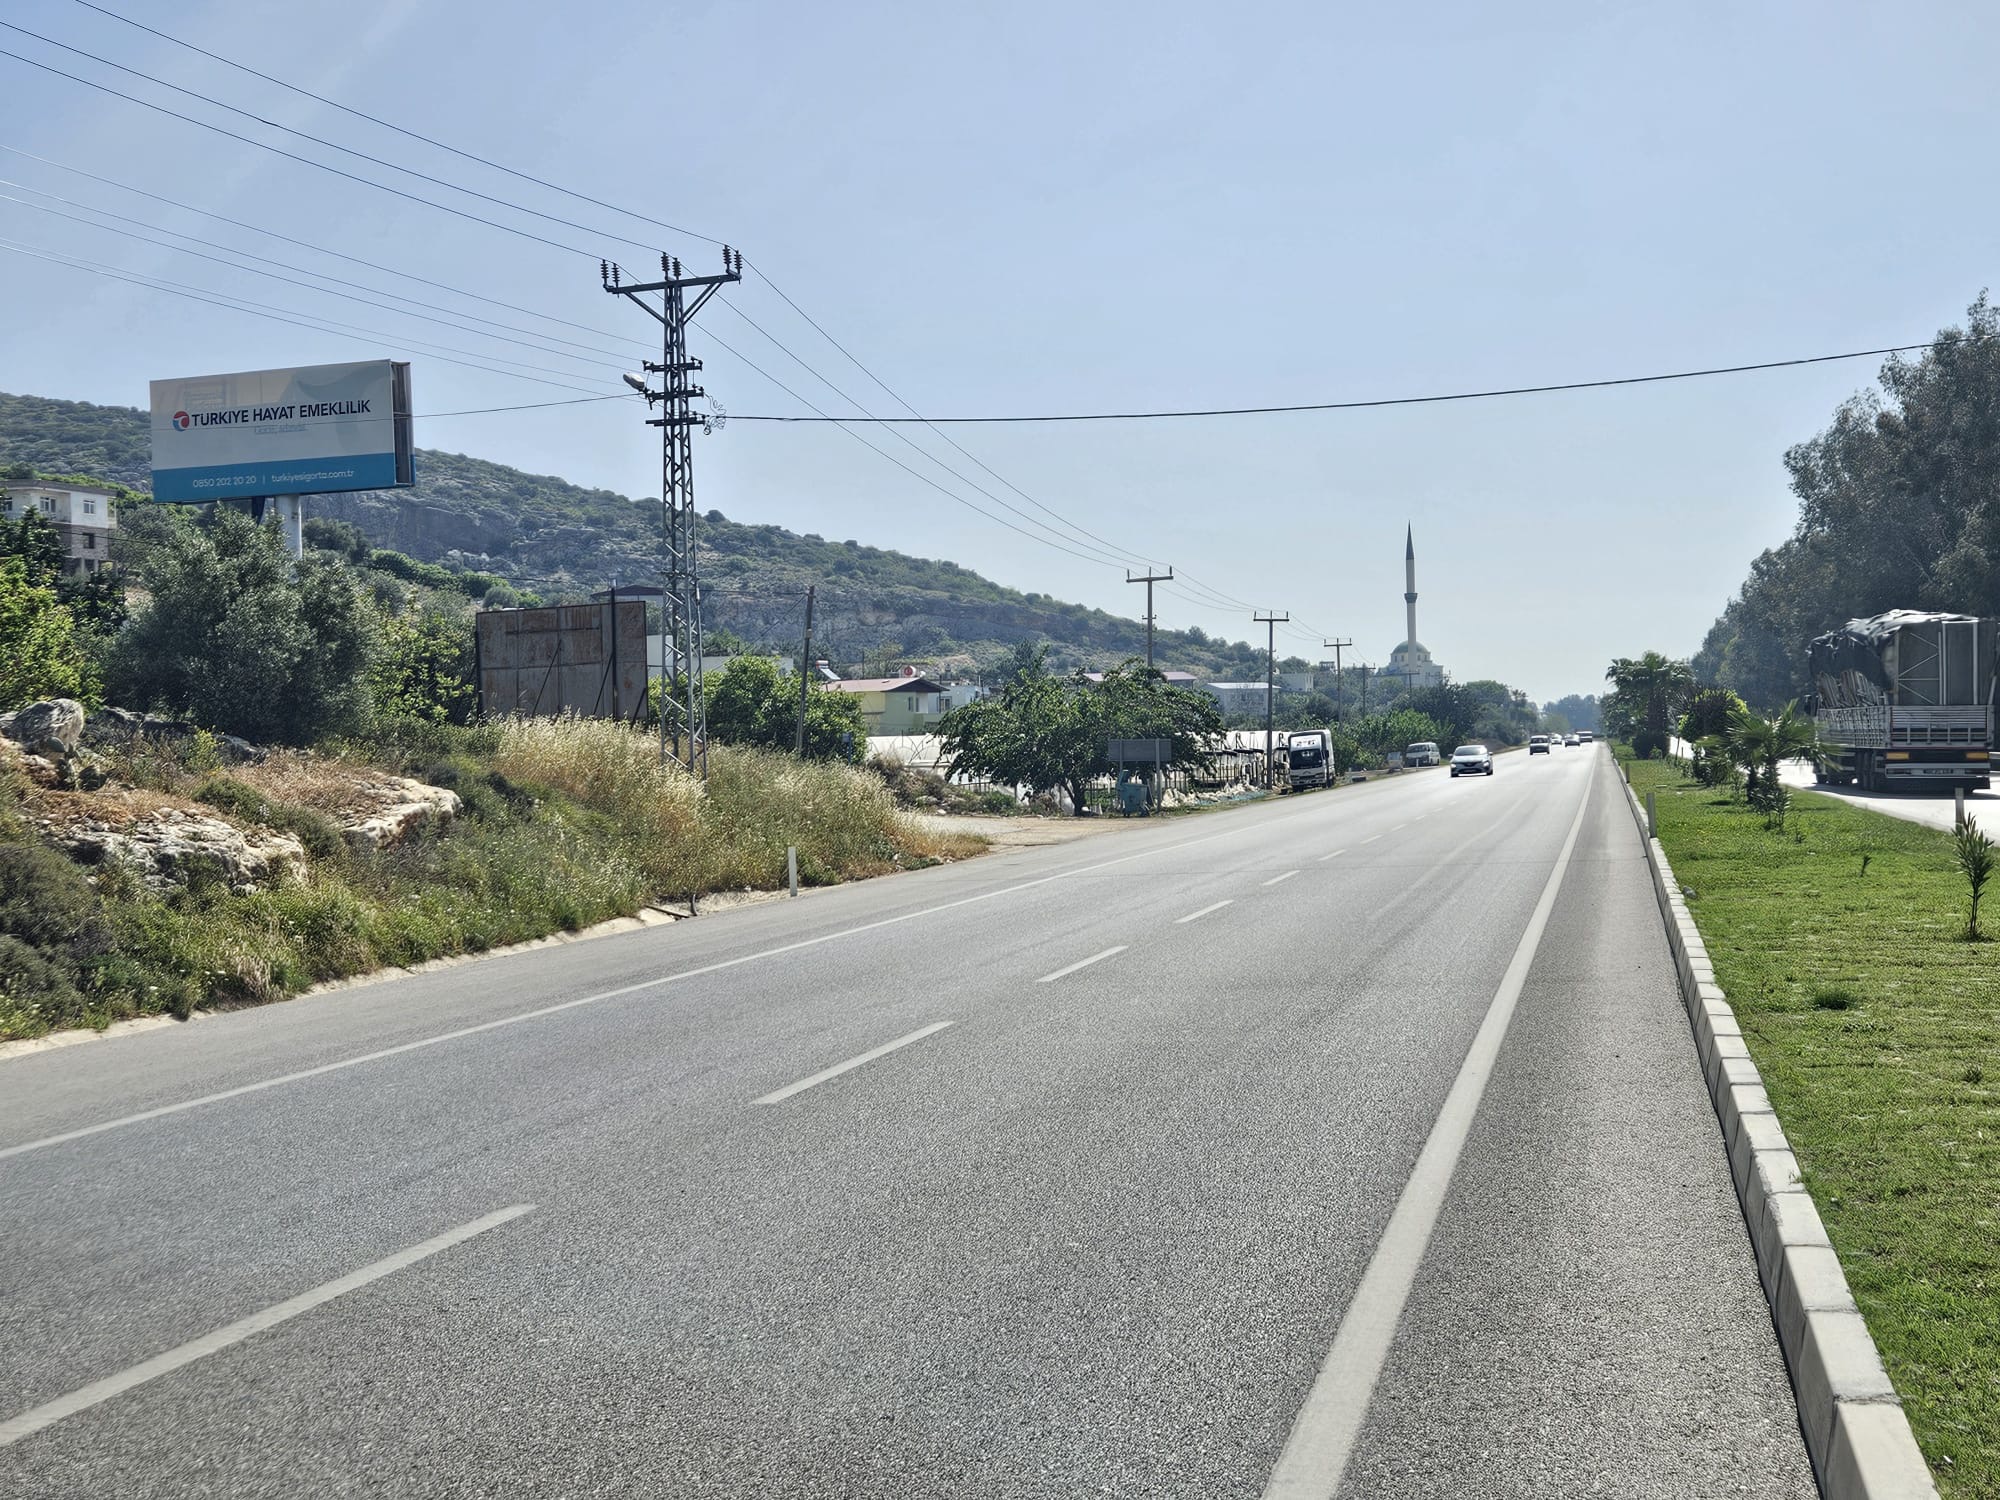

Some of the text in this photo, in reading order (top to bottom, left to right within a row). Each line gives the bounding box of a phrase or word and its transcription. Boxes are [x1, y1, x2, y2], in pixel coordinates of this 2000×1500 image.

[253, 405, 295, 422] HAYAT
[299, 399, 371, 418] EMEKLİLİK
[192, 475, 257, 488] 0850 202 20 20
